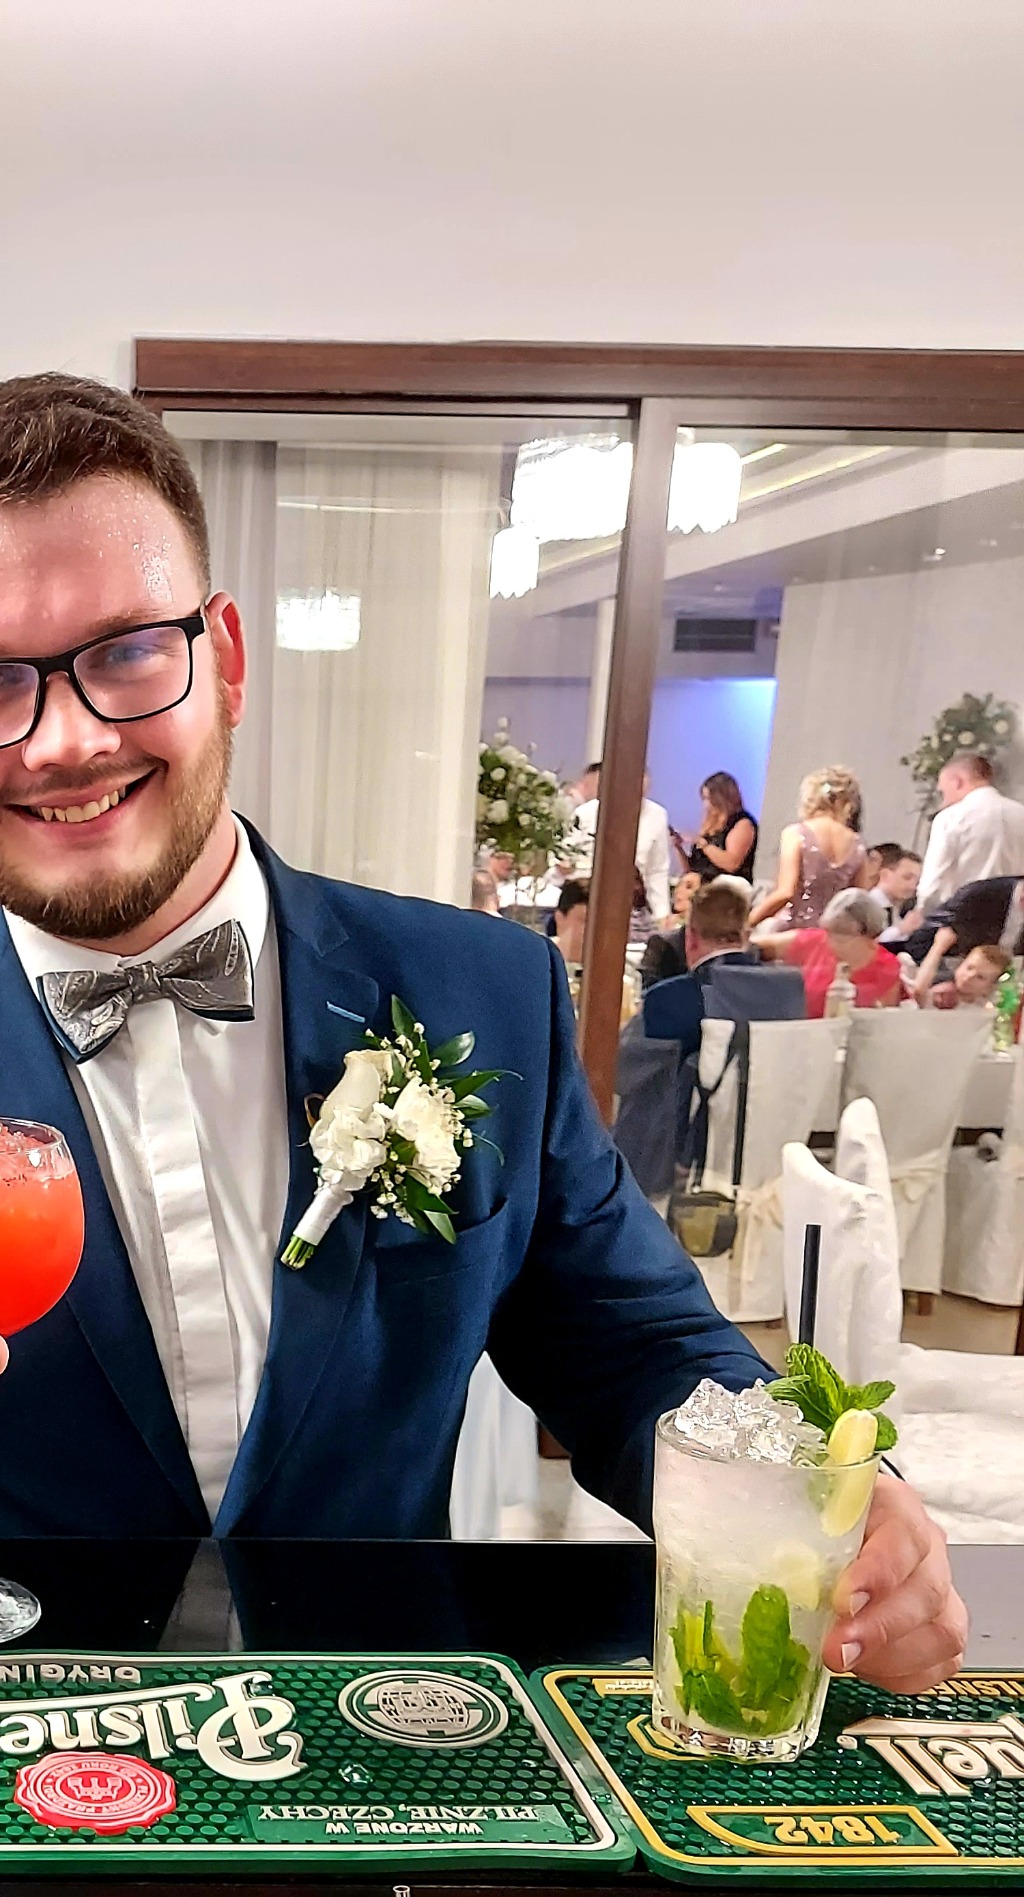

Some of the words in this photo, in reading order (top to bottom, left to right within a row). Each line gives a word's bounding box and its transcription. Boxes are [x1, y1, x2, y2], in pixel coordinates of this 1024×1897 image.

[922, 1680, 1024, 1698] ILSNE
[257, 1804, 395, 1822] CZECHY
[397, 1803, 540, 1822] PILZNIE,
[325, 1821, 351, 1835] W
[355, 1821, 484, 1835] WARZONE
[763, 1815, 903, 1845] 1842
